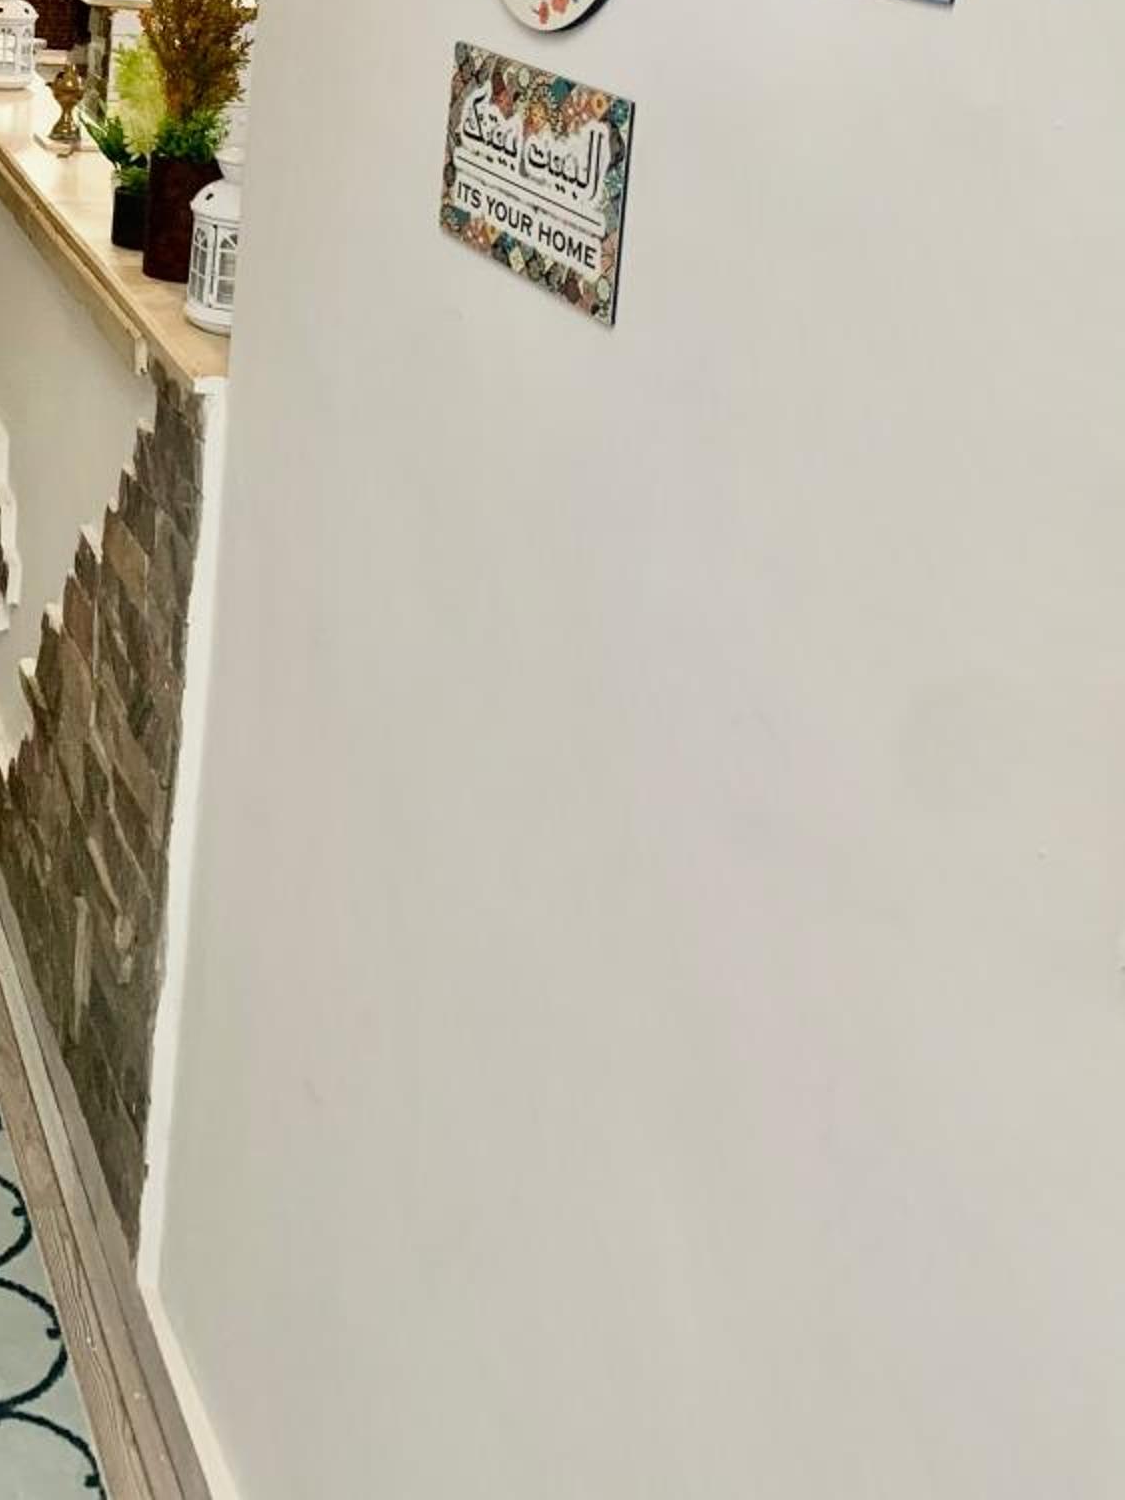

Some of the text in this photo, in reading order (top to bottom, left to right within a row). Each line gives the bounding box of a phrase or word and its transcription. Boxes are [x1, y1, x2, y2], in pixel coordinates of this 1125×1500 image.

[463, 94, 603, 201] البيت بيتك
[456, 181, 597, 270] ITS YOUR HOME
